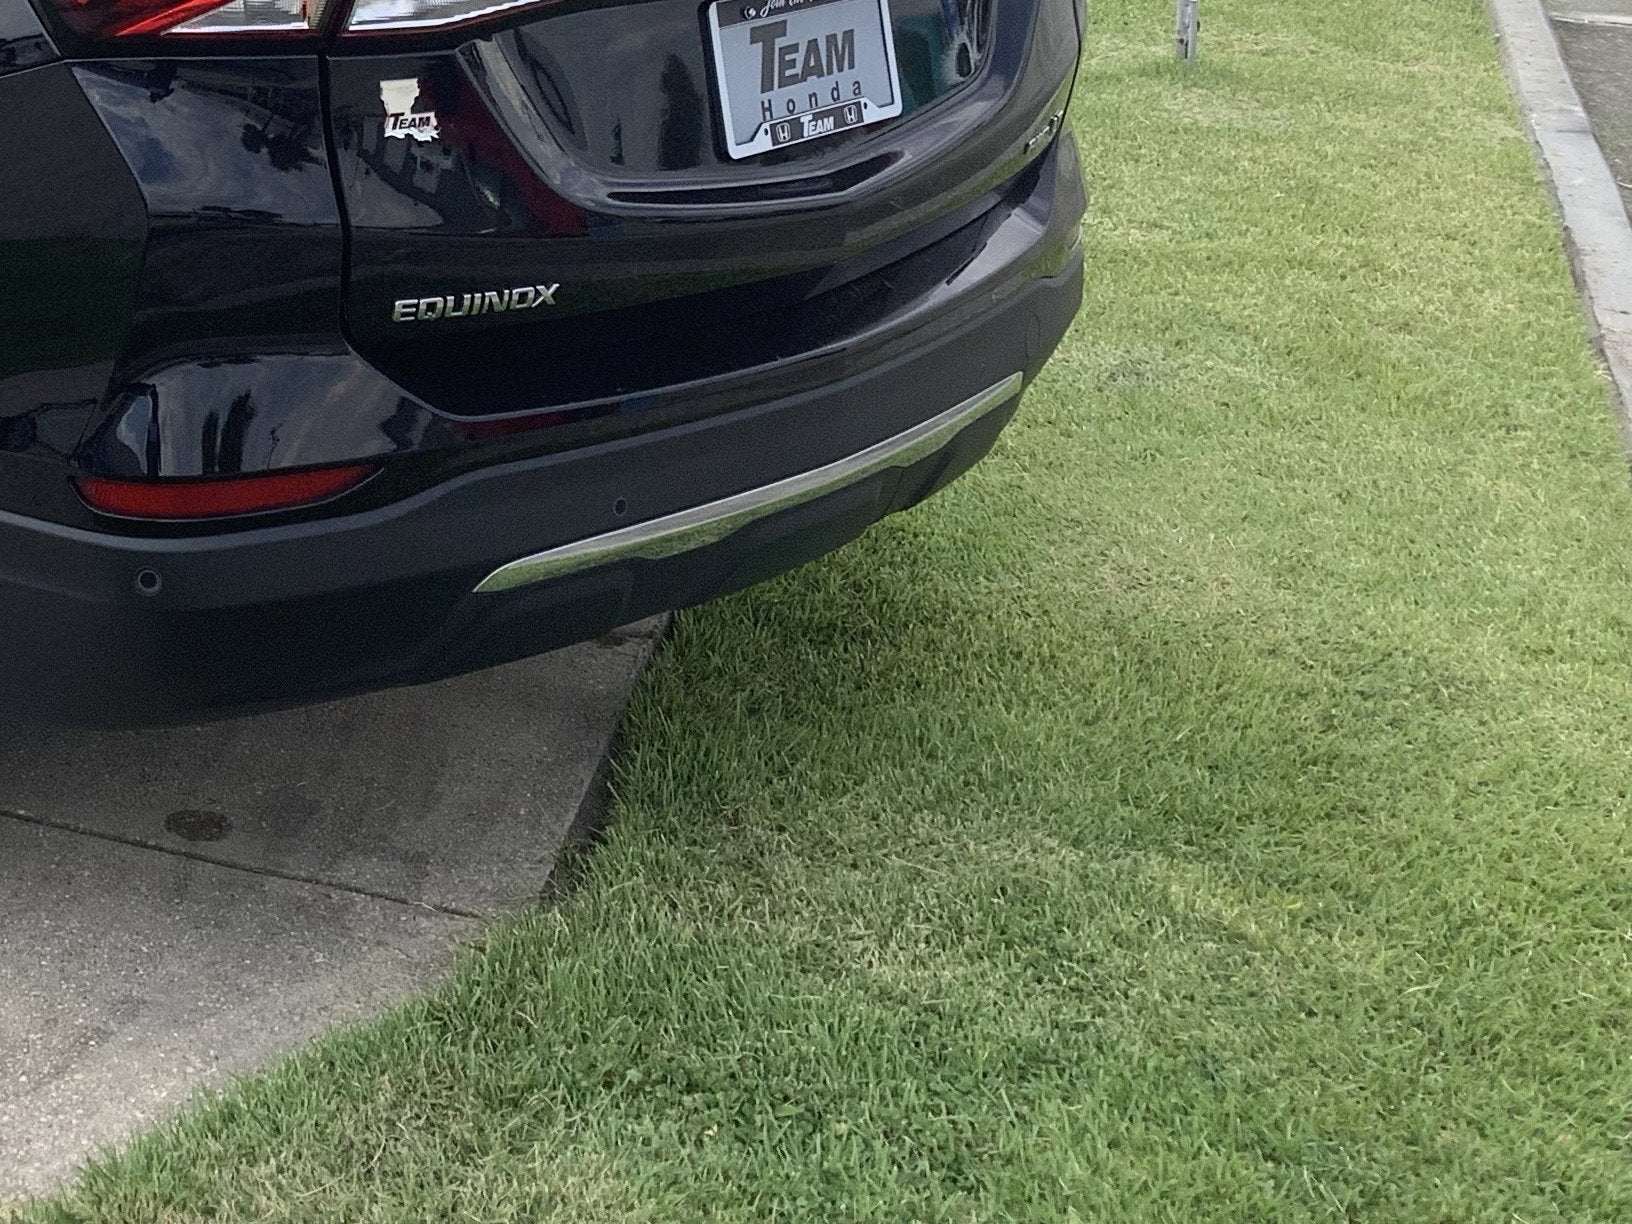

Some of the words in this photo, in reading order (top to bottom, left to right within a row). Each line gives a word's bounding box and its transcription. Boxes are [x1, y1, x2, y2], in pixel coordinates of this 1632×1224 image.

[749, 19, 855, 94] TEAM
[761, 80, 862, 122] Honda
[389, 112, 431, 130] TEAM
[800, 114, 834, 137] TEAM
[392, 283, 560, 322] EQUINOX
